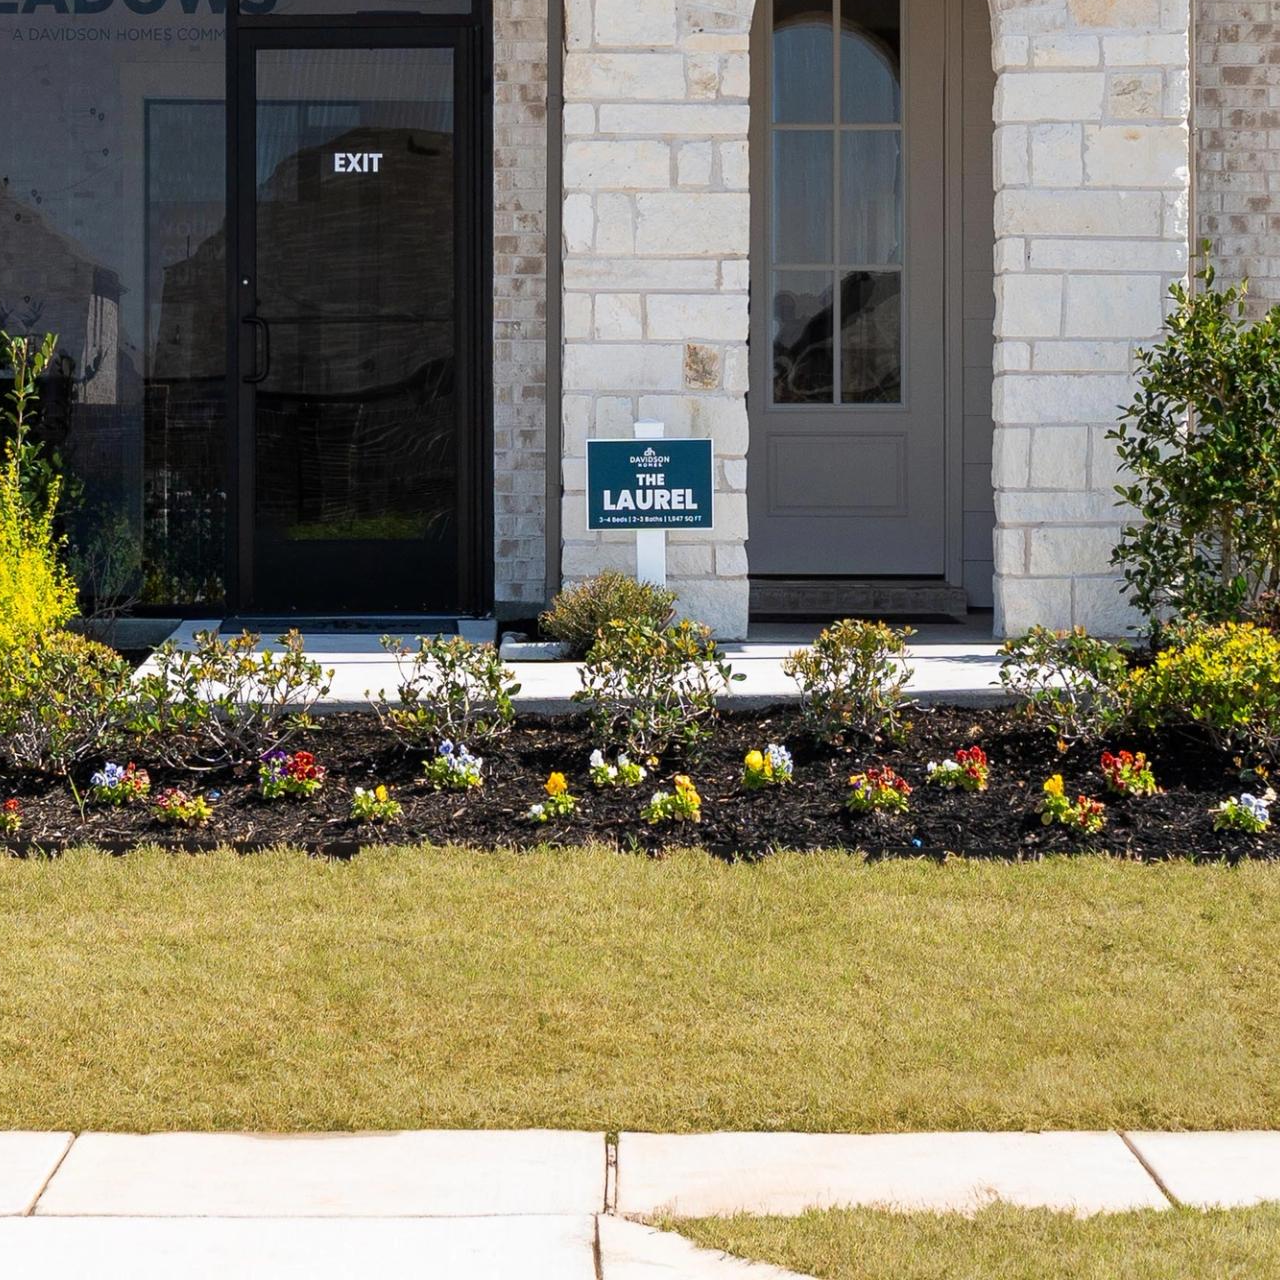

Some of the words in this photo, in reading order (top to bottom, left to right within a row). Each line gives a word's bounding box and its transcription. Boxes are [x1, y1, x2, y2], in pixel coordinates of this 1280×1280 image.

[12, 28, 24, 41] A
[28, 28, 112, 41] DAVIDSON
[116, 28, 172, 41] HOMES
[176, 28, 227, 41] COMM
[333, 153, 383, 173] EXIT
[629, 455, 670, 464] DAVIDSON
[636, 473, 665, 486] THE
[603, 488, 698, 511] LAUREL
